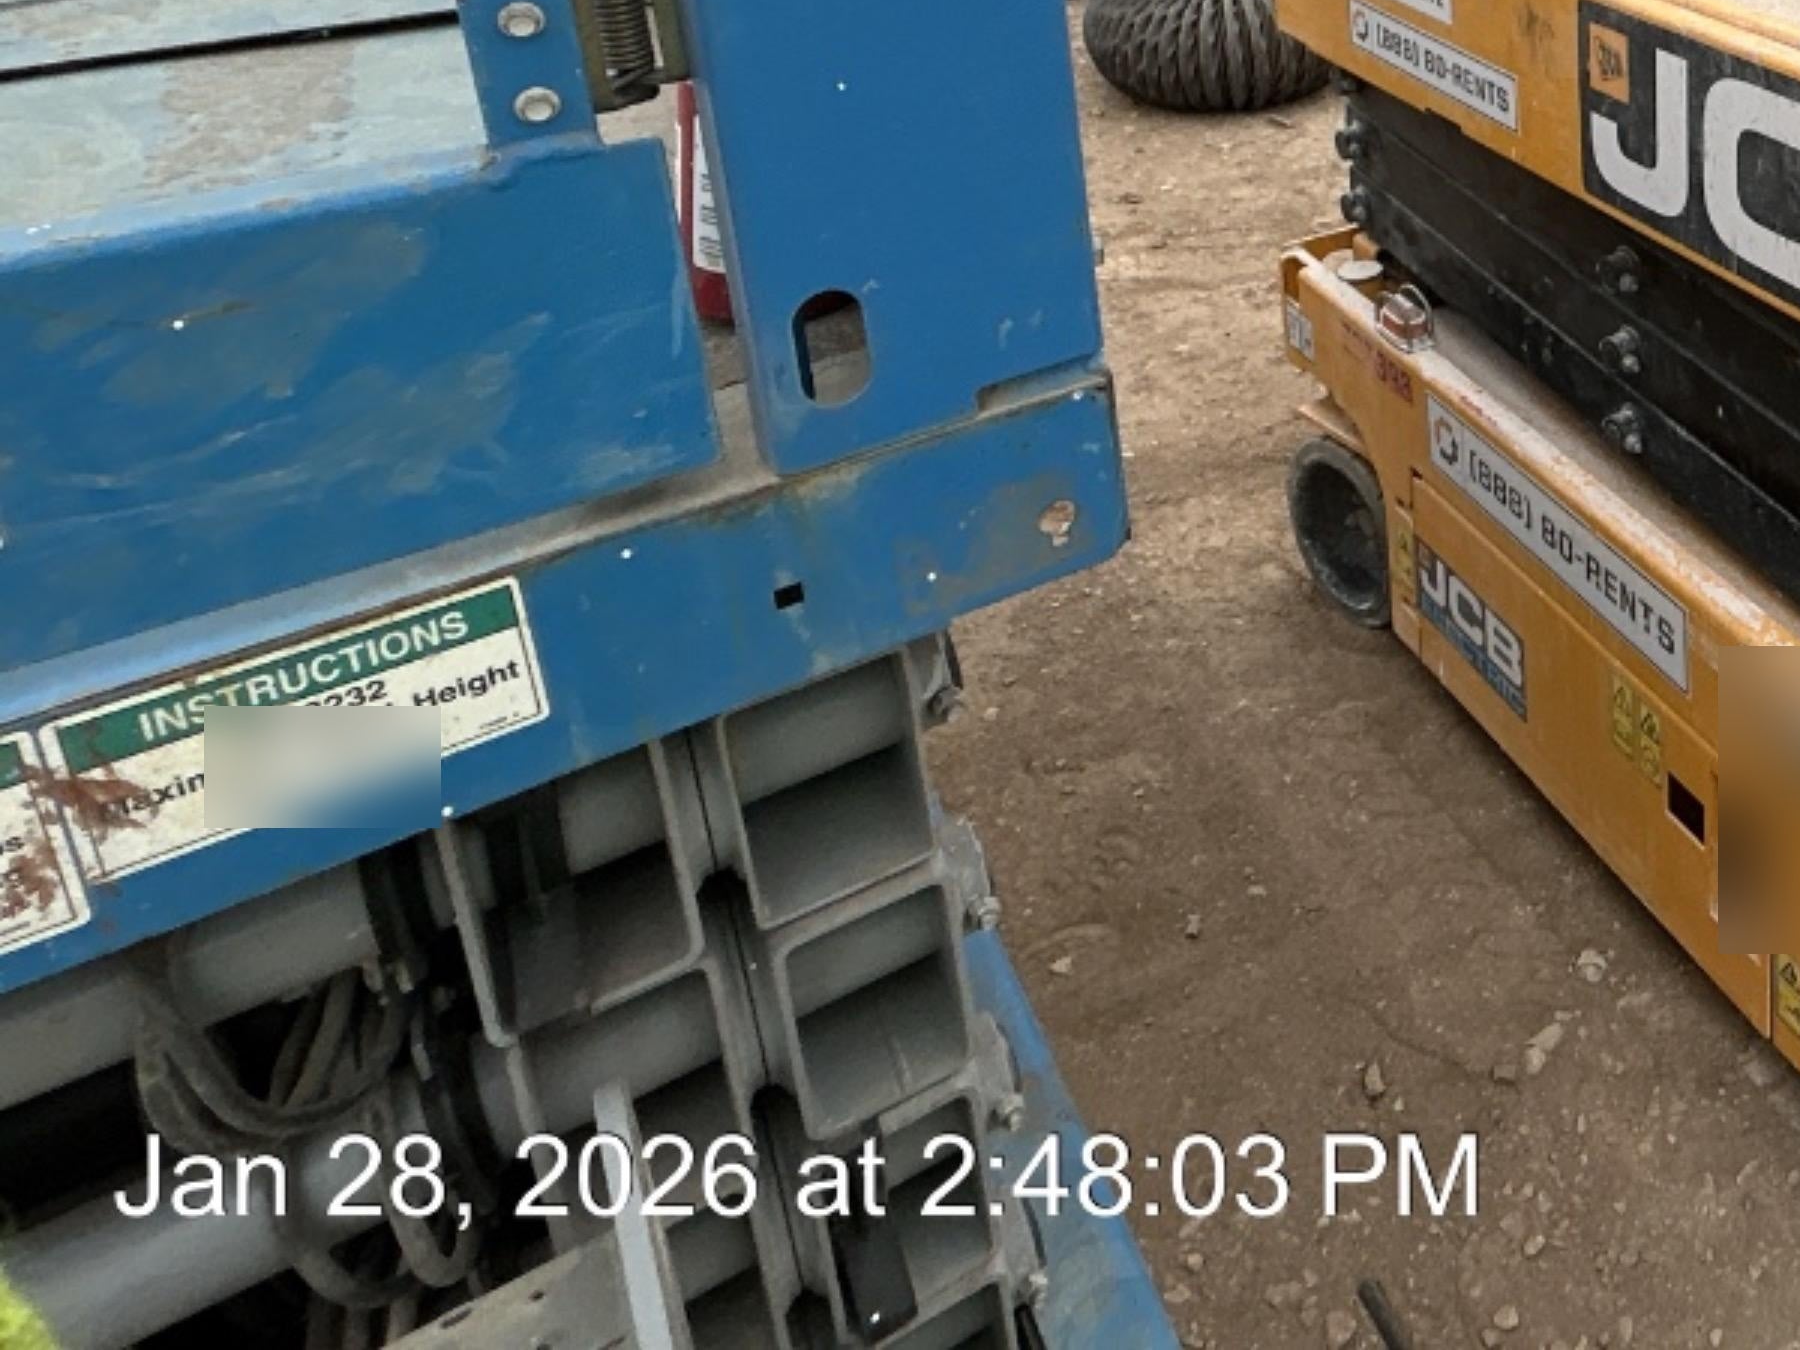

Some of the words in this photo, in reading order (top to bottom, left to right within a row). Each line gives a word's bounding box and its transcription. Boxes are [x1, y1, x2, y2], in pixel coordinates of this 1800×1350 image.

[1469, 449, 1532, 530] (888)
[1420, 559, 1524, 687] JCB
[138, 610, 470, 742] INSTRUCTIONS
[412, 659, 521, 708] Height
